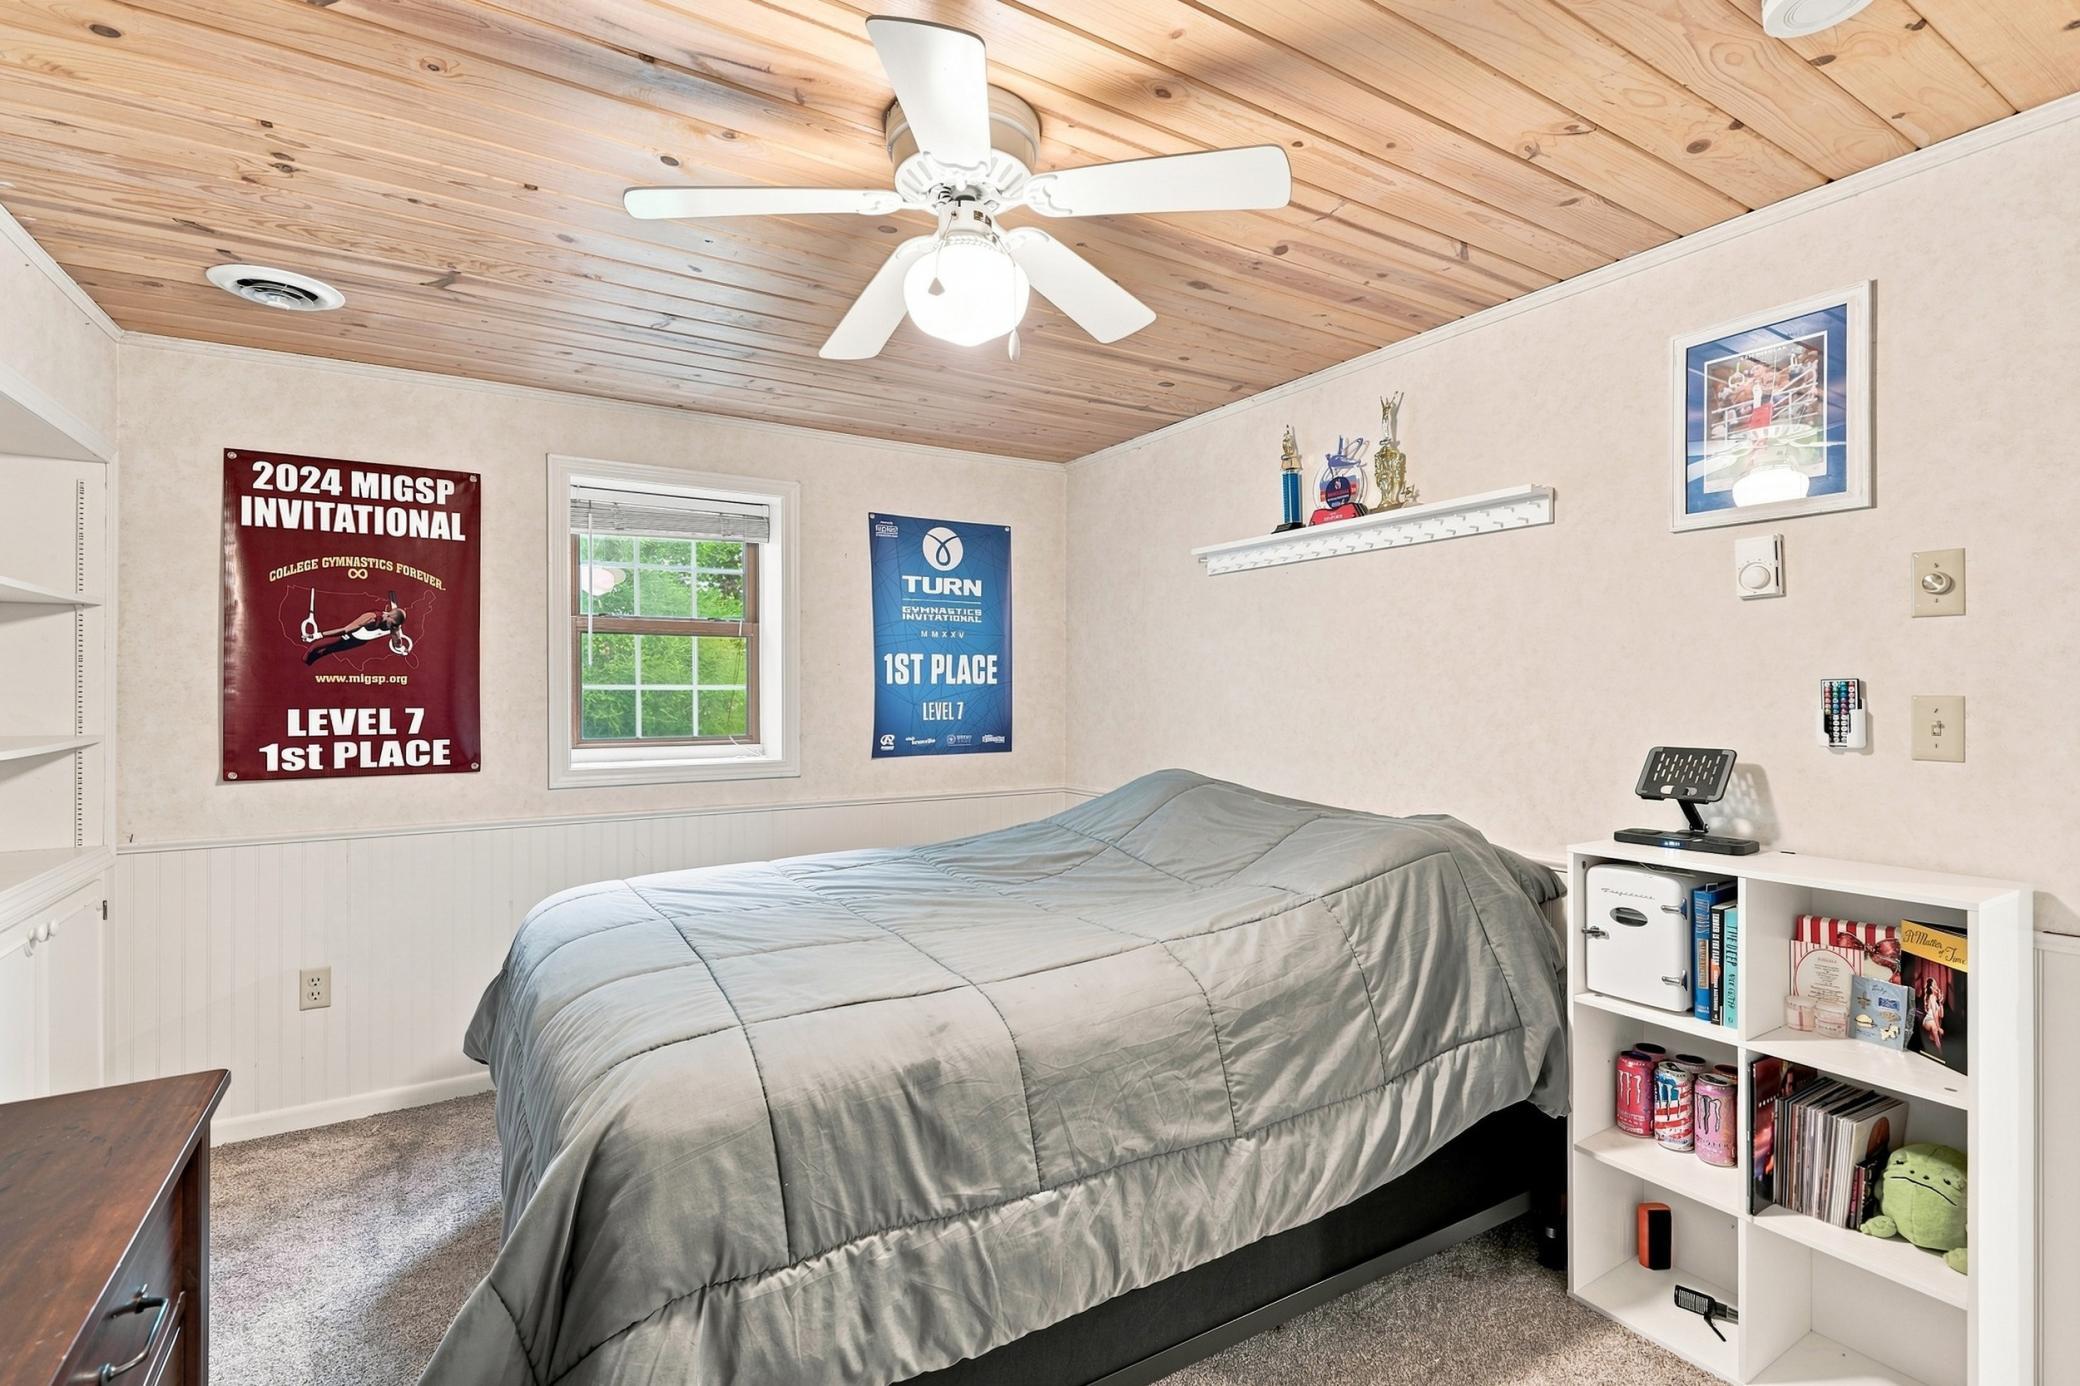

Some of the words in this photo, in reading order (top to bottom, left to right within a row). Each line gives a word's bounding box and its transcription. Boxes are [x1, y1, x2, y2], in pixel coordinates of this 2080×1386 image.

[252, 461, 342, 496] 2024
[351, 471, 455, 505] MIGSP
[241, 496, 466, 541] INVITATIONAL
[269, 558, 319, 582] COLLEGE
[321, 556, 394, 571] GYMNASTICS
[902, 575, 982, 597] TURN
[902, 605, 982, 616] GYMNASTICS
[902, 613, 982, 623] INVITATIONAL
[315, 673, 408, 685] www.migsp.org
[884, 653, 924, 685] 1ST
[931, 654, 998, 685] PLACE
[287, 708, 397, 737] LEVEL
[405, 707, 425, 735] 7
[922, 702, 955, 721] LEVEL
[957, 702, 964, 720] 7
[259, 743, 323, 772] 1st
[334, 739, 451, 769] PLACE
[1726, 925, 1738, 943] THE
[1915, 930, 1943, 949] Matter
[1726, 944, 1738, 967] DEEP
